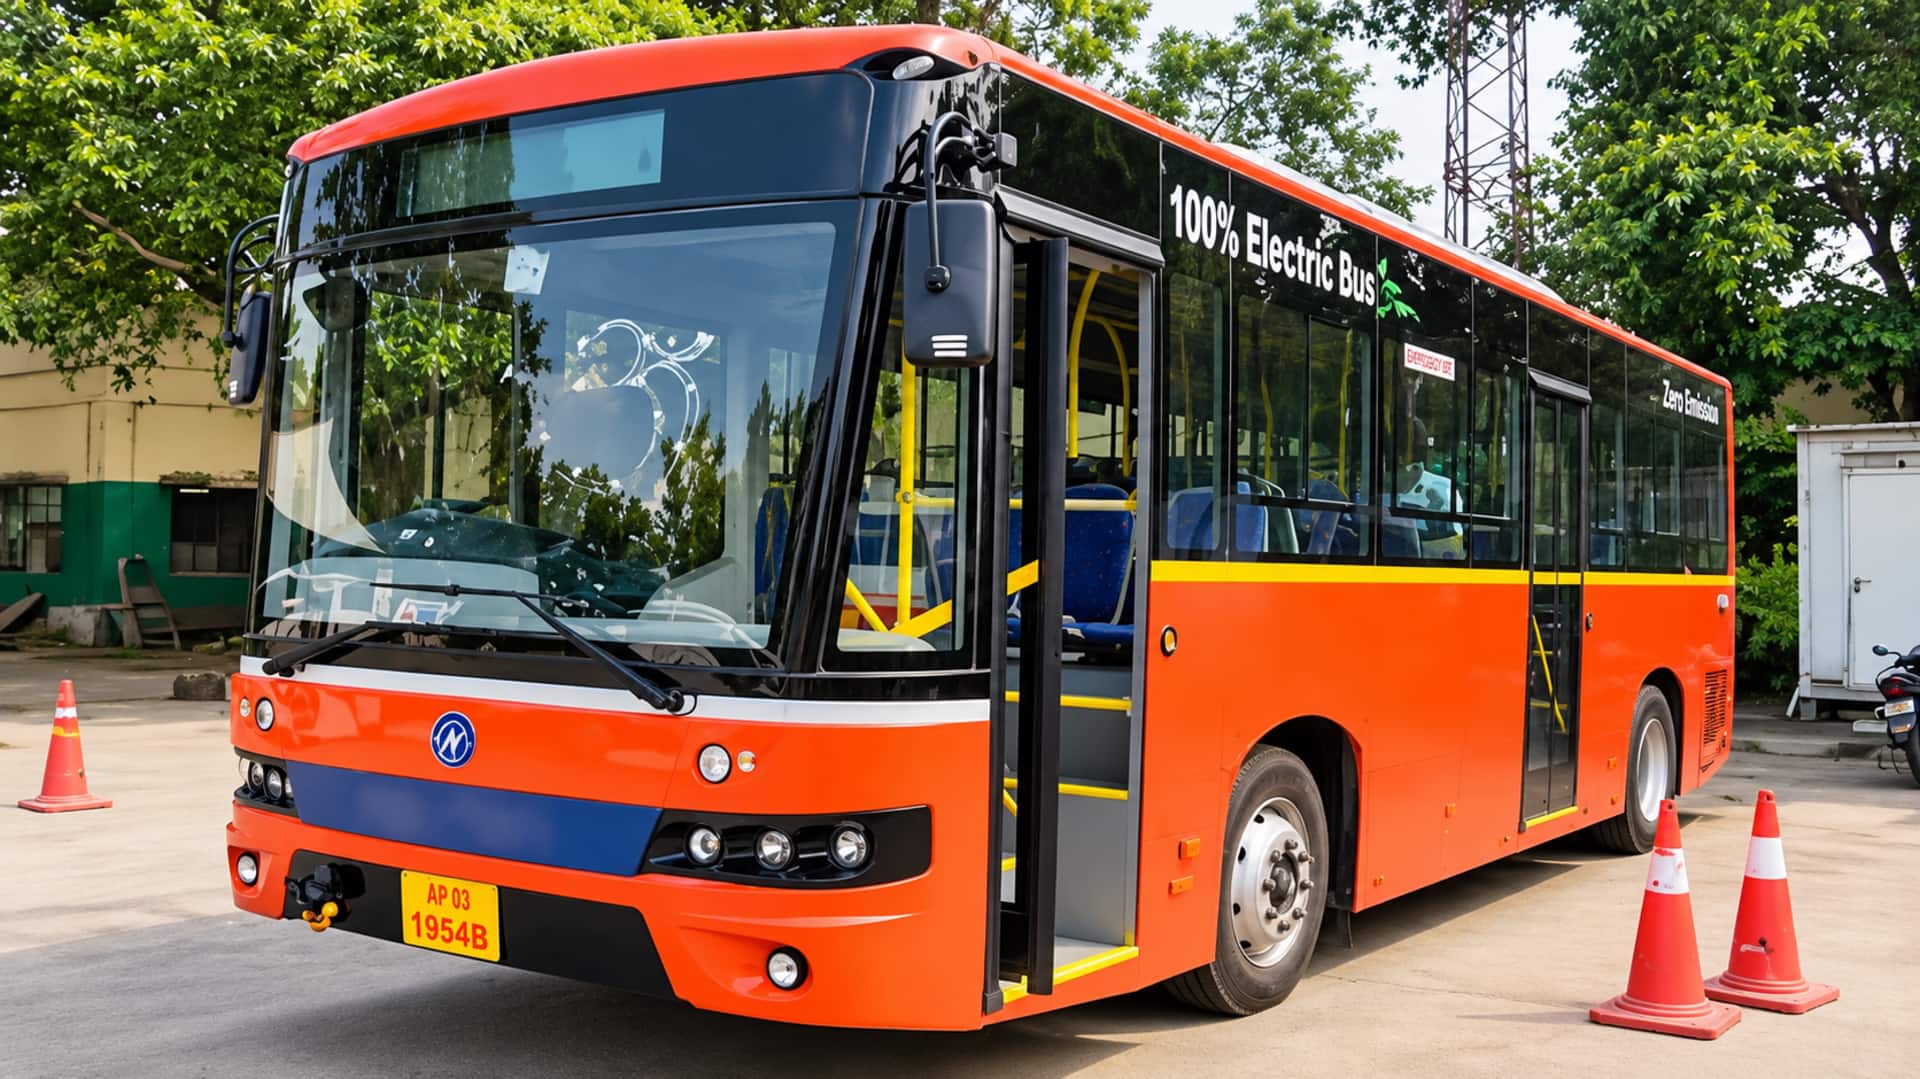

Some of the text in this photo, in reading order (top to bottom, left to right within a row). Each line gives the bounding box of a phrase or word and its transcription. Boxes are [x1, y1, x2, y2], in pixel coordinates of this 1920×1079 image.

[1170, 184, 1375, 306] 100% Electric Bus
[1663, 378, 1719, 425] Zero Emission
[427, 882, 471, 911] AP 03
[411, 911, 488, 950] 1954B
